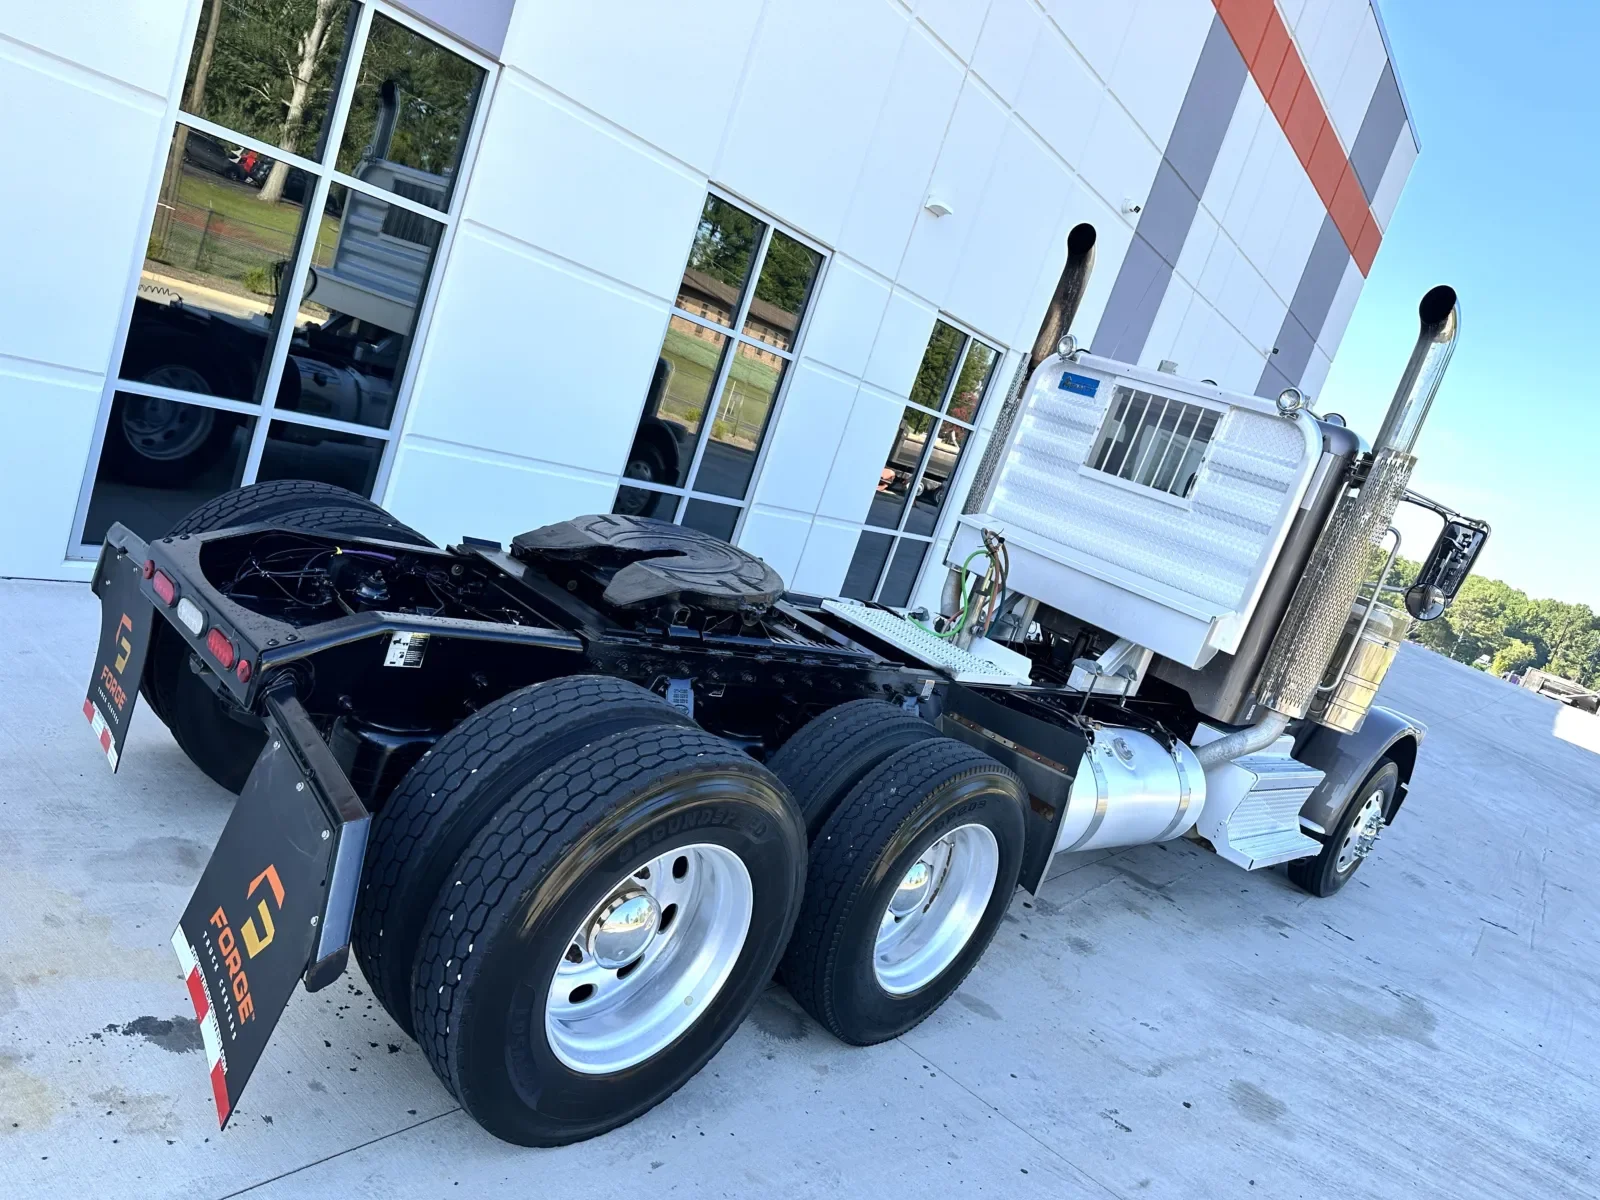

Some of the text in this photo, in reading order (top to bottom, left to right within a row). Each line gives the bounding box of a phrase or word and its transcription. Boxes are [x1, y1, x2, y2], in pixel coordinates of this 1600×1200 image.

[100, 665, 126, 711] FORGE
[202, 930, 237, 1041] TRUCK CENTERS
[210, 905, 254, 1025] FORGE
